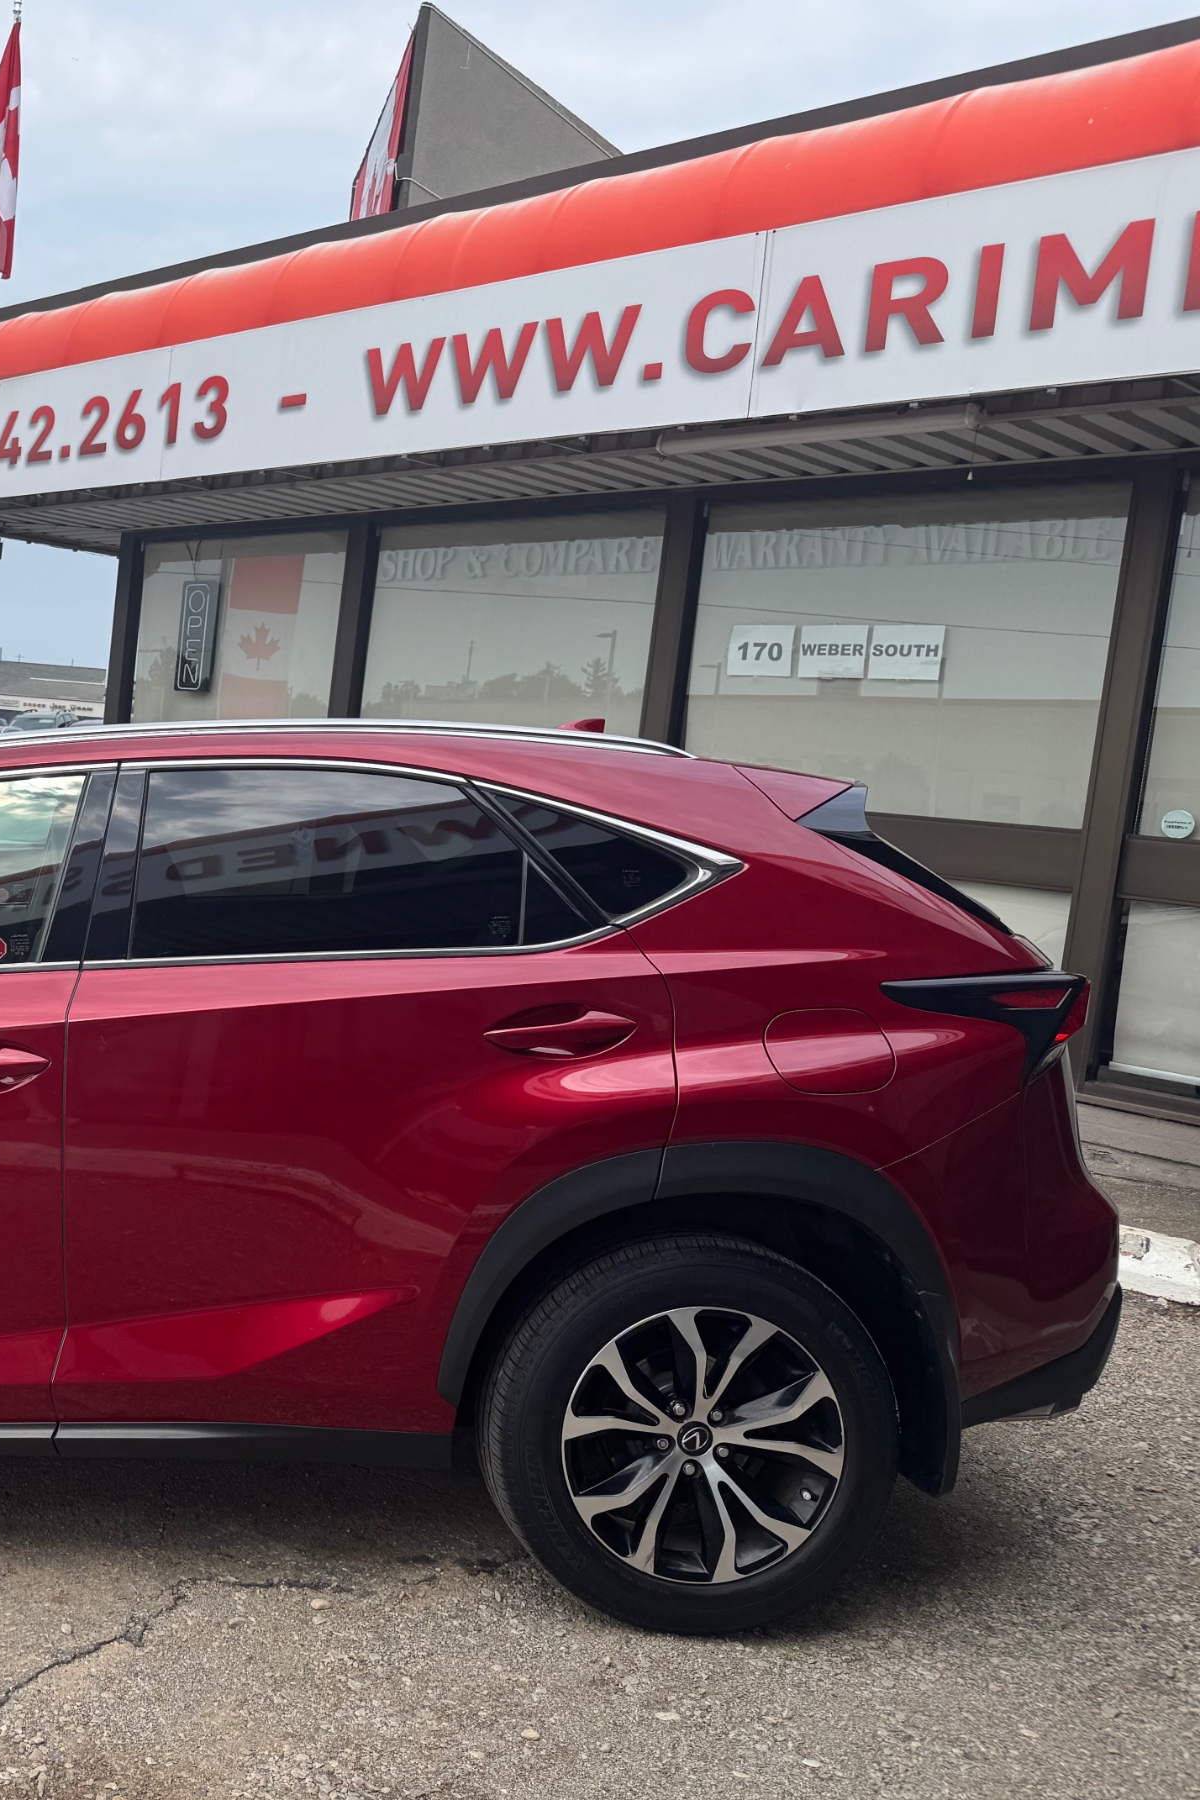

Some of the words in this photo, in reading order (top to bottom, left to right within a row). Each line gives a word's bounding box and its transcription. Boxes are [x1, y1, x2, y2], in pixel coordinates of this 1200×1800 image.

[366, 208, 1200, 416] WWW.CARIM
[379, 547, 454, 582] SHOP
[465, 546, 488, 579] &
[503, 537, 658, 578] COMPARE
[712, 528, 892, 570] WARRANTY
[904, 517, 1117, 566] AVAILABLE
[181, 588, 206, 685] OPEN
[737, 642, 783, 661] 170
[801, 643, 864, 657] WEBER
[872, 643, 939, 658] SOUTH
